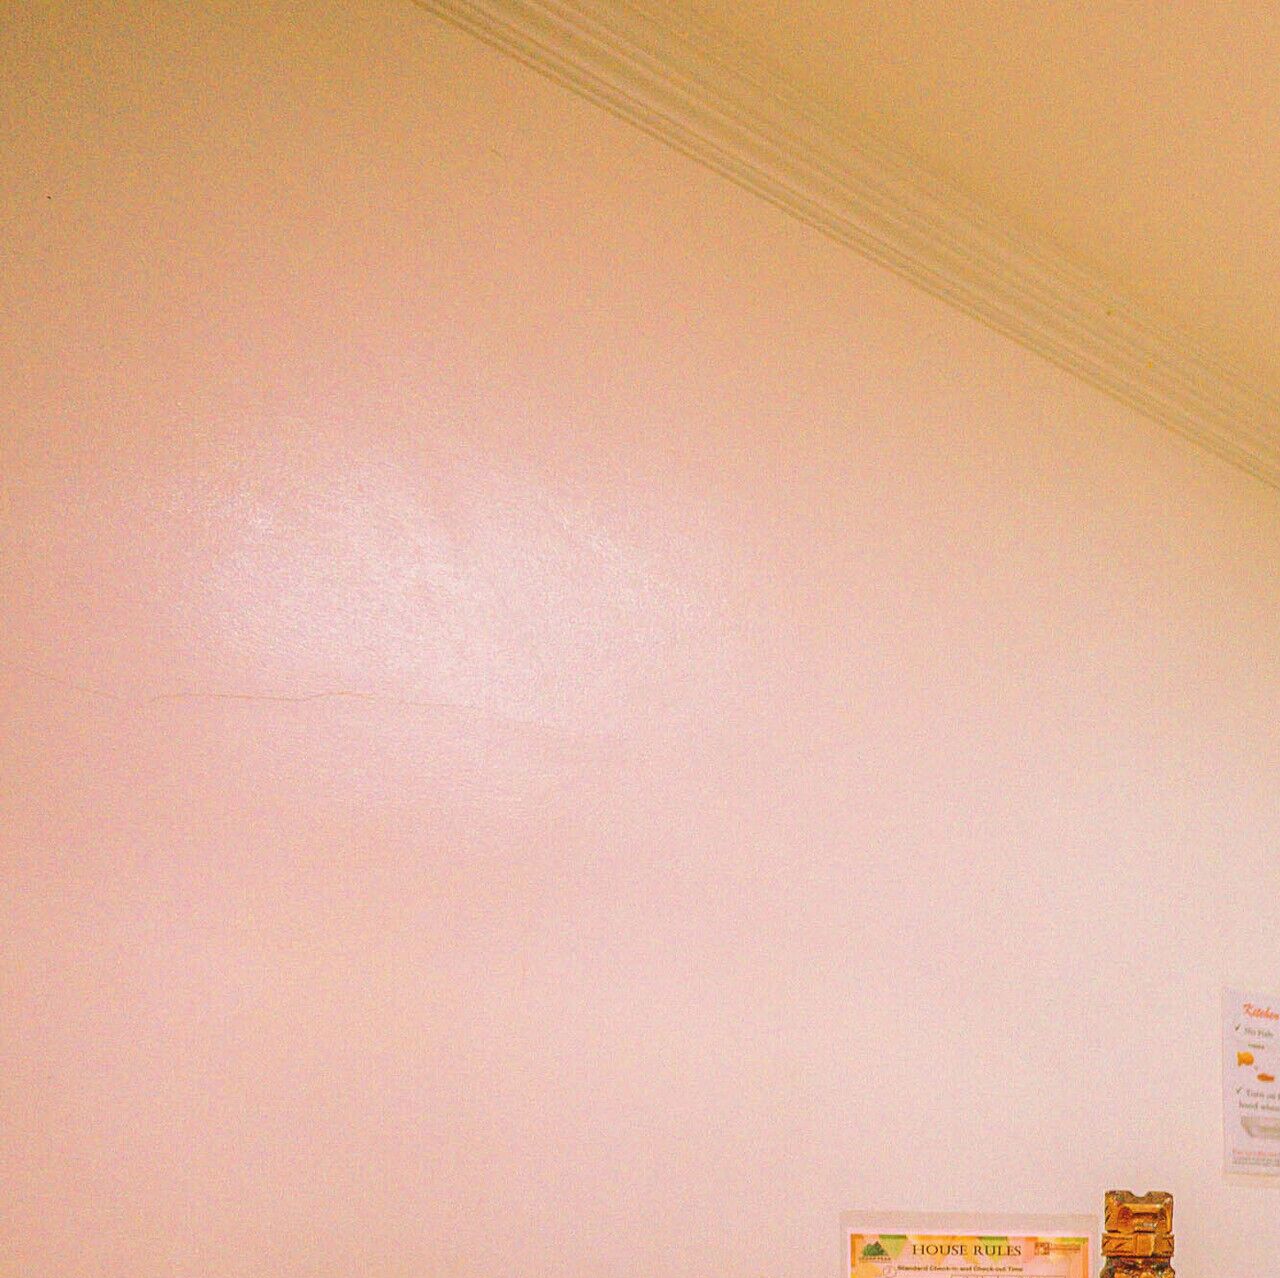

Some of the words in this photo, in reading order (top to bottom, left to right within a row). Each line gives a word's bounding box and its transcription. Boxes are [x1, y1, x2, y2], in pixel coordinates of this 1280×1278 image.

[1242, 1003, 1280, 1021] Kitchen
[912, 1243, 967, 1256] HOUSE
[973, 1244, 1022, 1256] RULES
